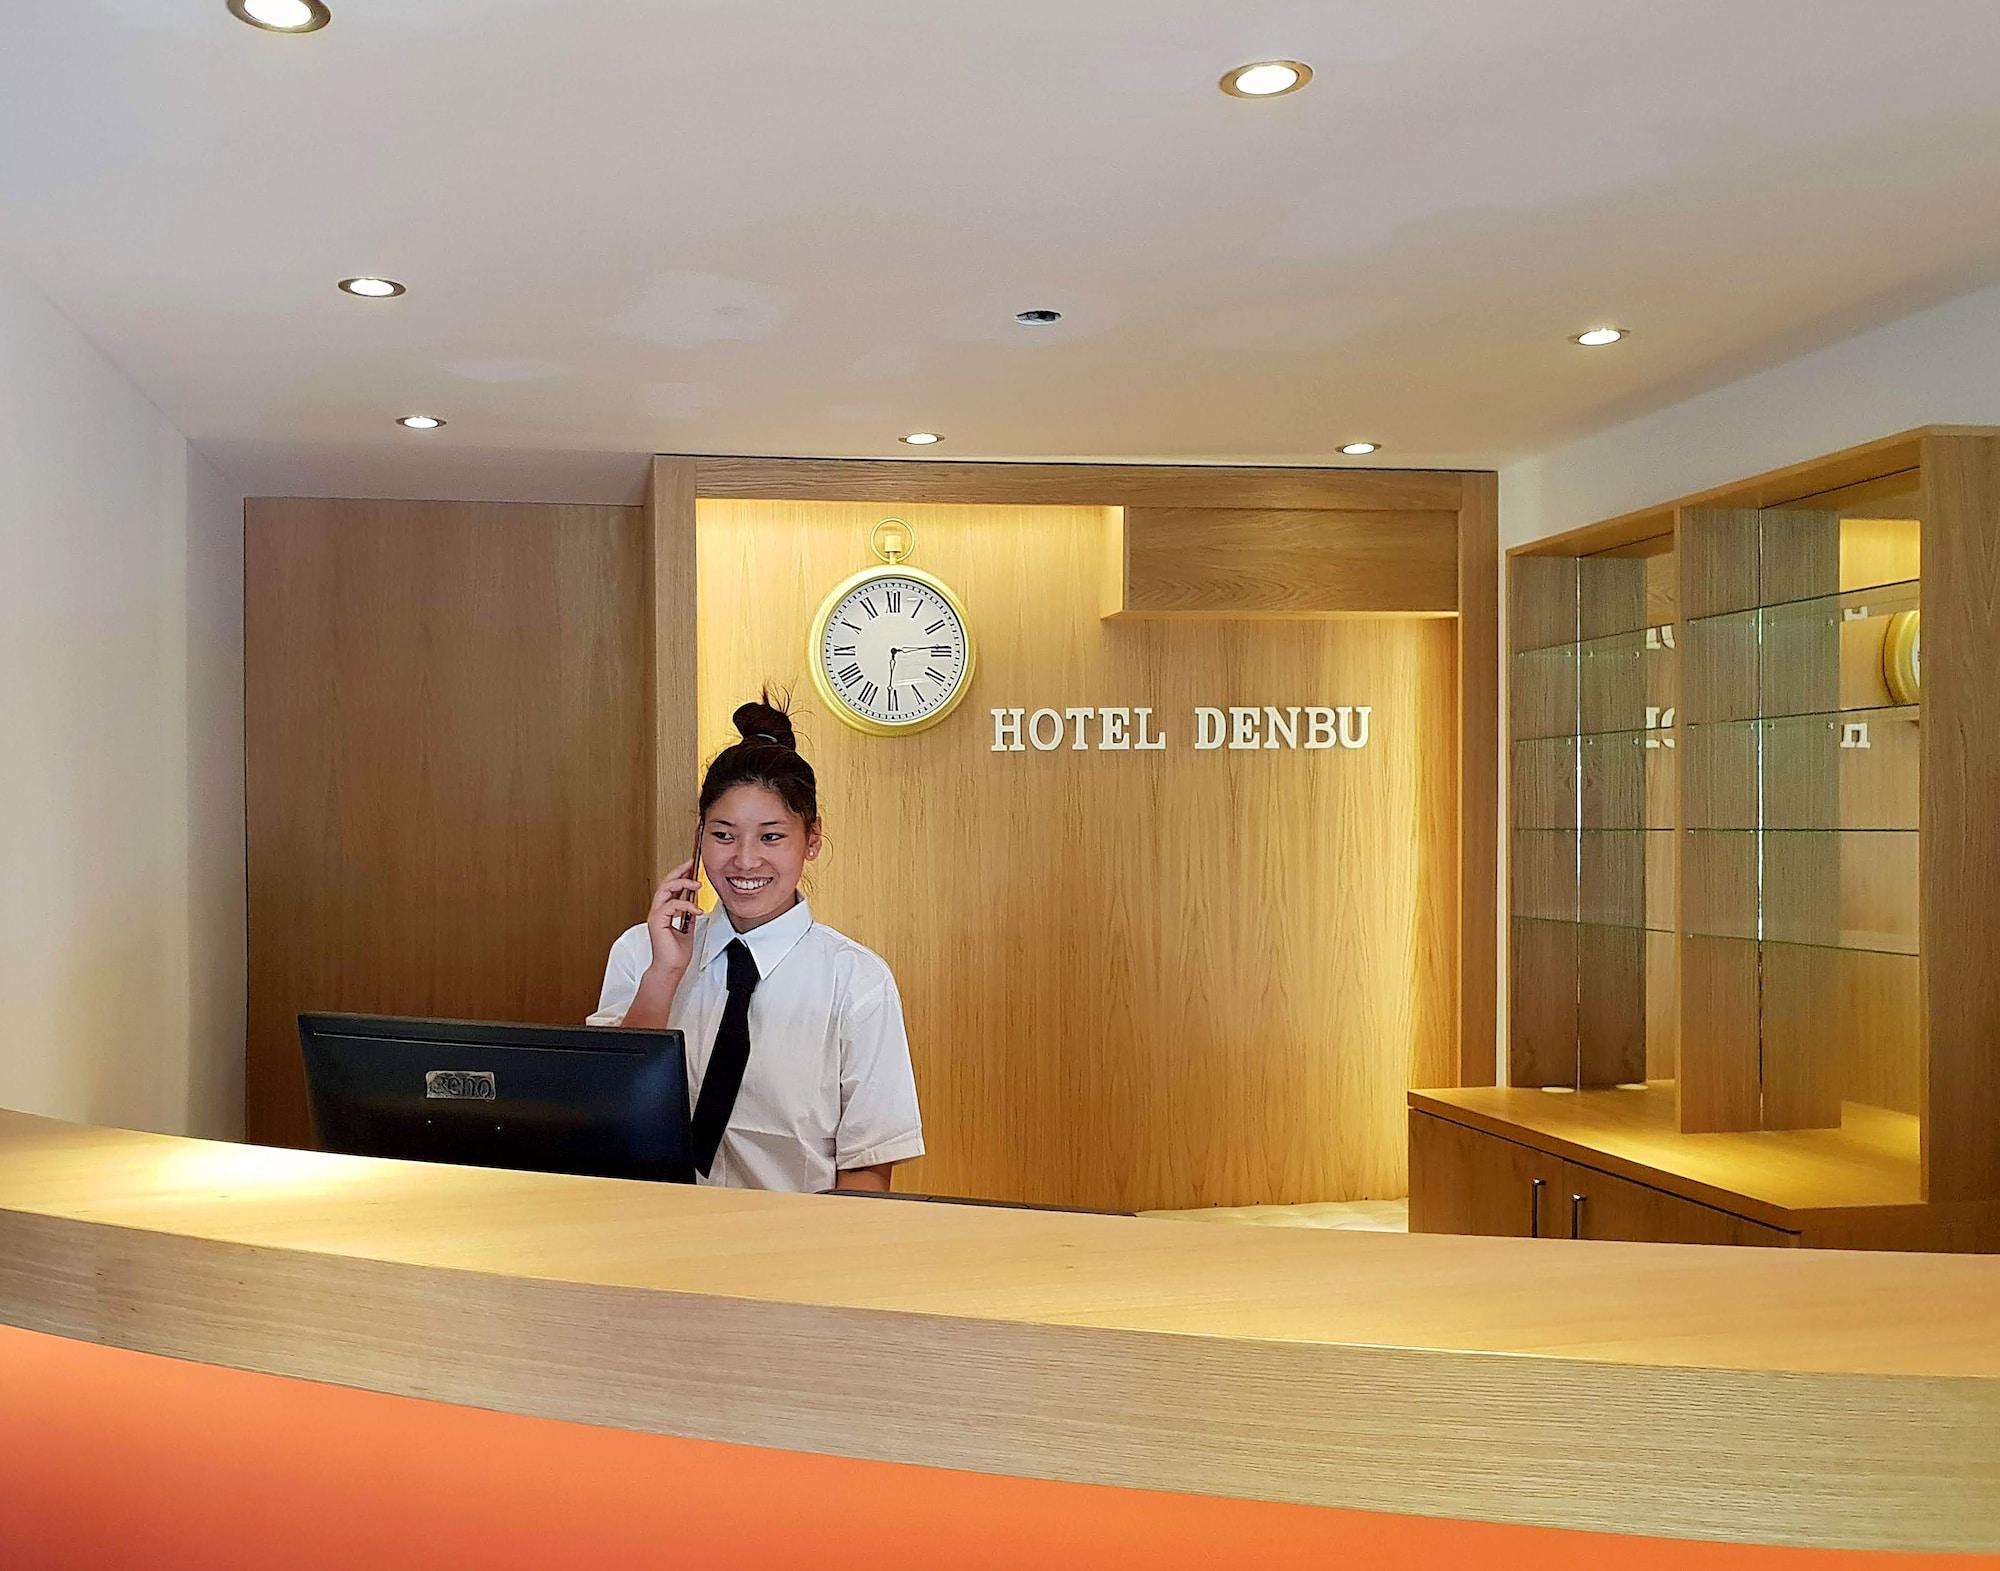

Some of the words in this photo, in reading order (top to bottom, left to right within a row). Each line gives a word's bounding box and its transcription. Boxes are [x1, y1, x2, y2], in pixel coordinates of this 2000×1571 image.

[886, 591, 901, 613] XII
[990, 706, 1167, 752] HOTEL
[1194, 705, 1372, 750] DENBU
